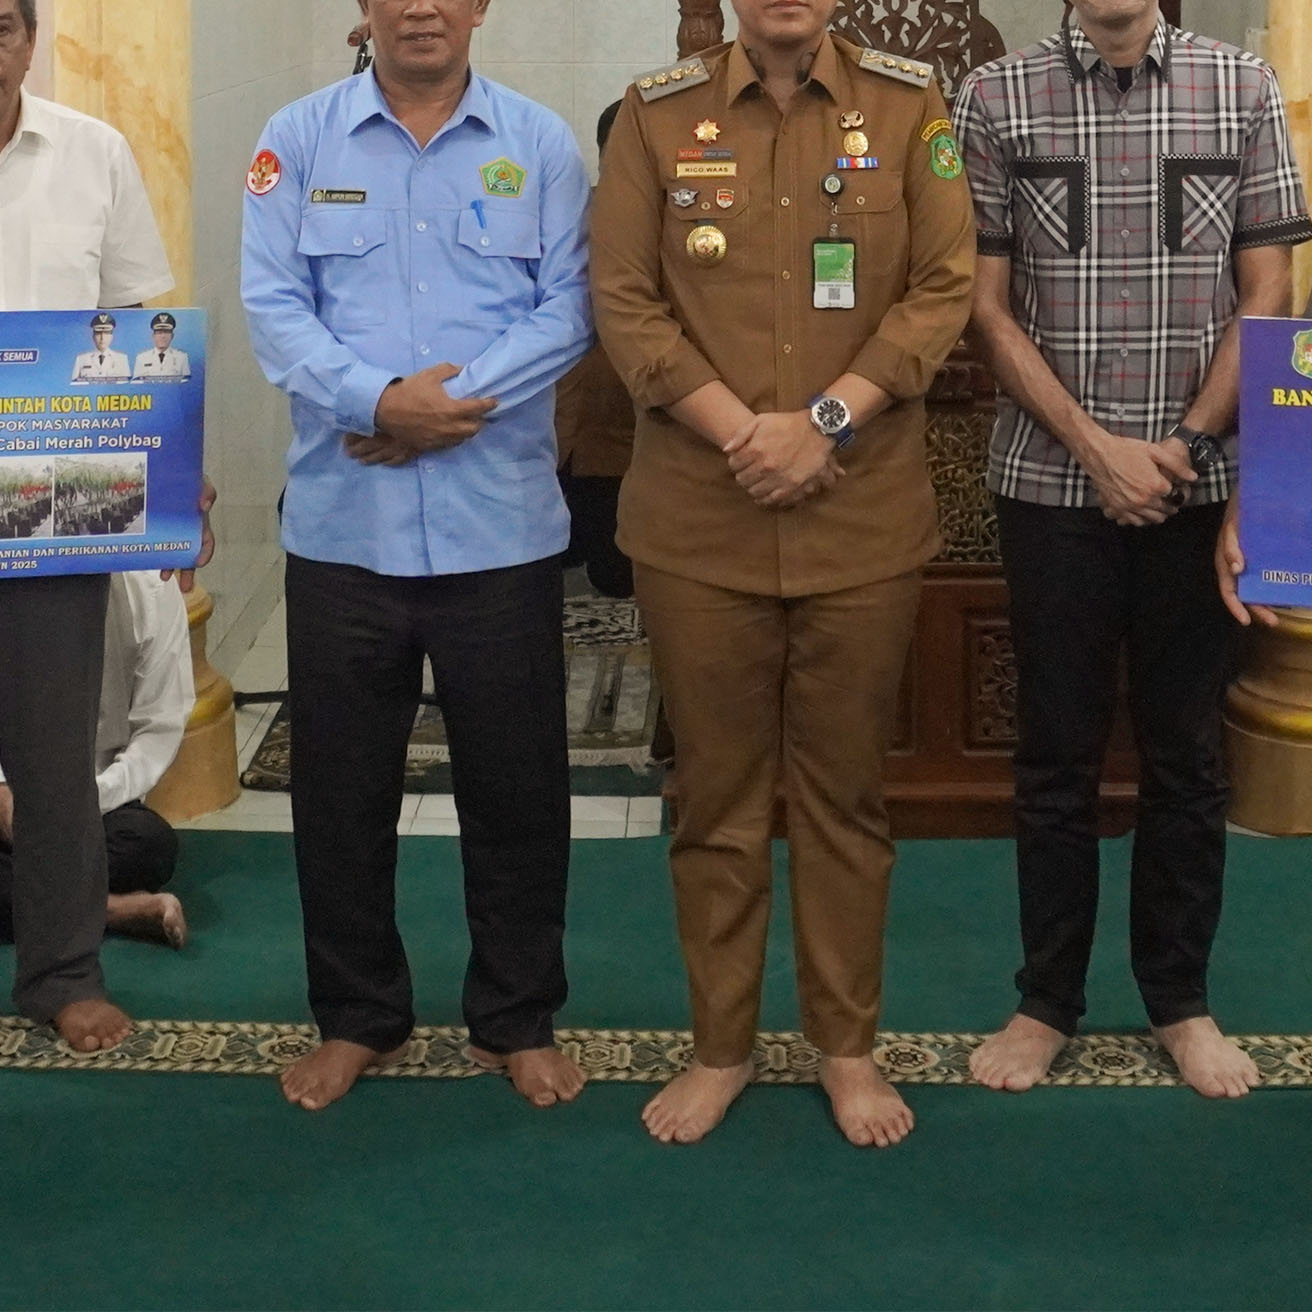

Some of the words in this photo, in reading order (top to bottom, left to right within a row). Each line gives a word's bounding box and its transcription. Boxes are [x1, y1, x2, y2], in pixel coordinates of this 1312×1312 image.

[3, 351, 35, 363] SEMUA
[50, 396, 92, 414] KOTA
[96, 394, 152, 412] MEDAN
[31, 416, 129, 431] MASYARAKAT
[44, 434, 94, 450] Merah
[97, 433, 163, 452] Polybag
[32, 546, 56, 558] DAN
[58, 544, 120, 556] PERIKANAN
[121, 543, 151, 555] KOTA
[154, 541, 191, 553] MEDAN
[11, 559, 38, 571] 2025
[1262, 570, 1299, 585] DINAS
